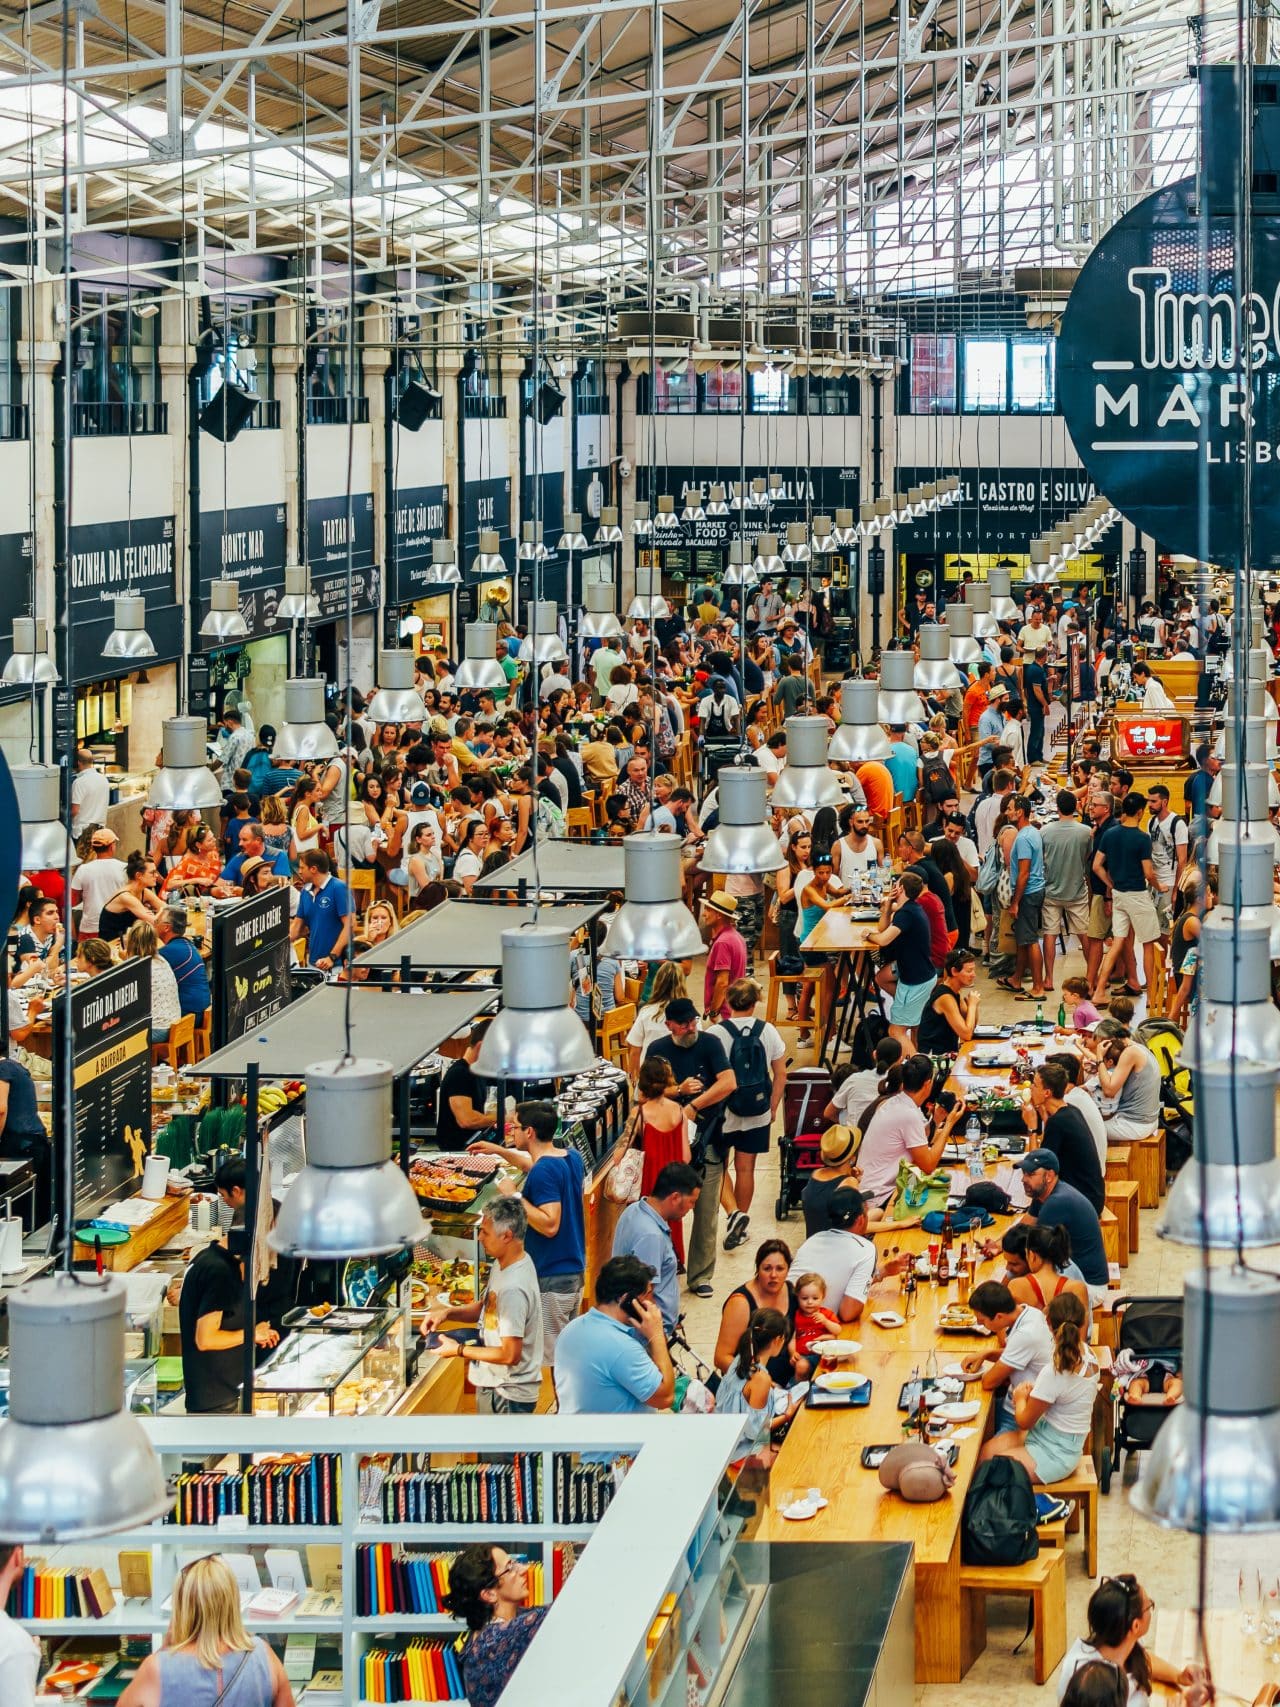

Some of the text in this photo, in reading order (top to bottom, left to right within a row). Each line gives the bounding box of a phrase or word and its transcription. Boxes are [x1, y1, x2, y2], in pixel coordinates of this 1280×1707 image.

[1128, 266, 1270, 369] Time
[979, 482, 1035, 502] CASTRO
[1041, 482, 1049, 502] E
[1054, 482, 1096, 503] SILVA
[695, 521, 727, 529] MARKET
[695, 528, 727, 538] FOOD
[222, 529, 264, 564] MONTE MAR
[685, 538, 718, 546] BACALHAU
[71, 541, 173, 588] OZINHA DA FELICIDADE
[252, 917, 259, 938] DE
[259, 913, 266, 934] LA
[82, 995, 104, 1029] LEITÃO
[104, 992, 114, 1017] DA
[114, 980, 139, 1011] RIBEIRA
